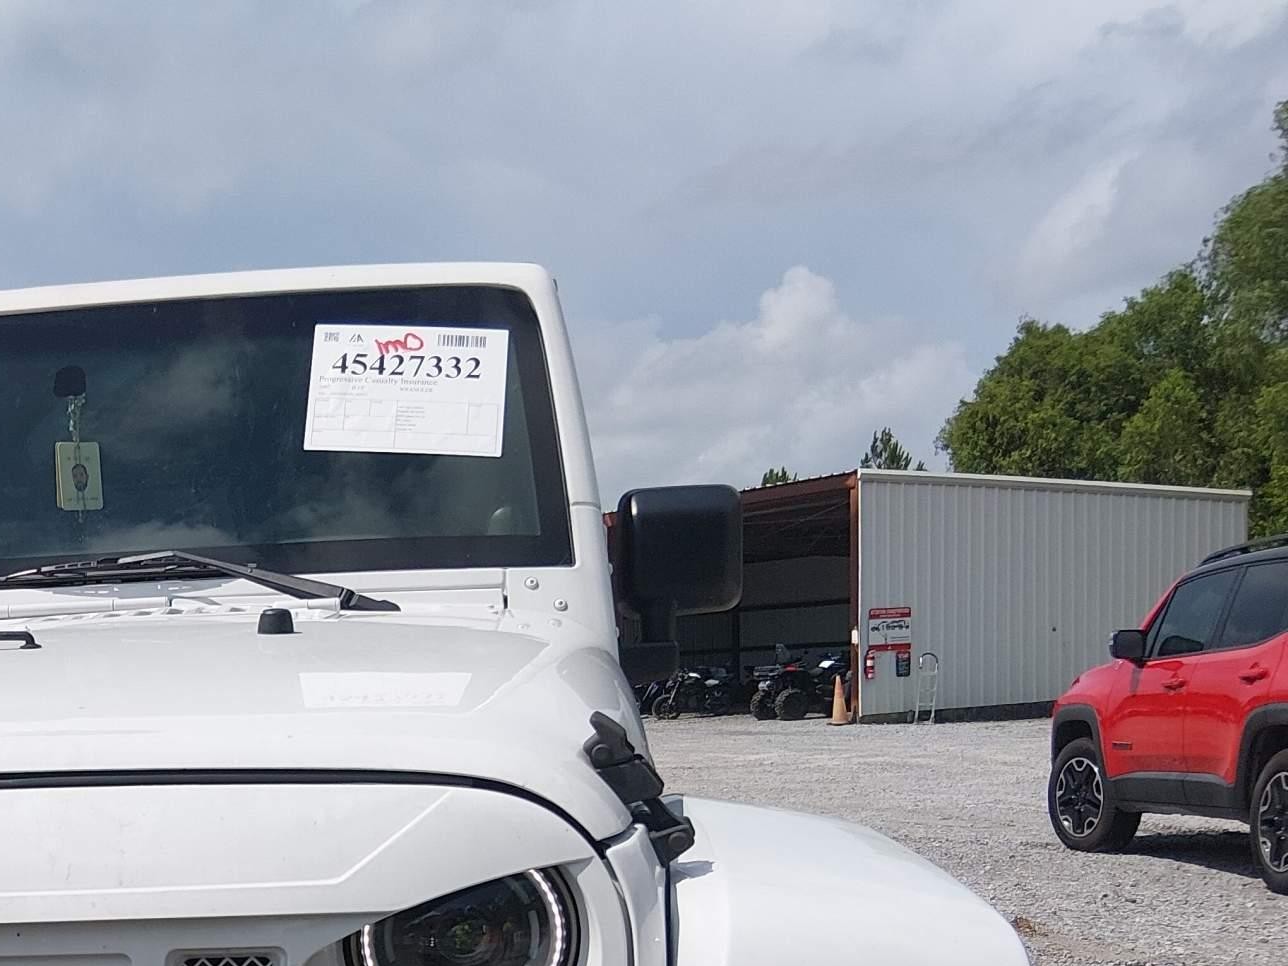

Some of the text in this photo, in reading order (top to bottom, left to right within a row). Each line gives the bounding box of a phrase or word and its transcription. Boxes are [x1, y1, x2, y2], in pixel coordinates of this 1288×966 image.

[332, 352, 481, 380] 45427332
[319, 375, 438, 386] Progressive Casualty Insurance
